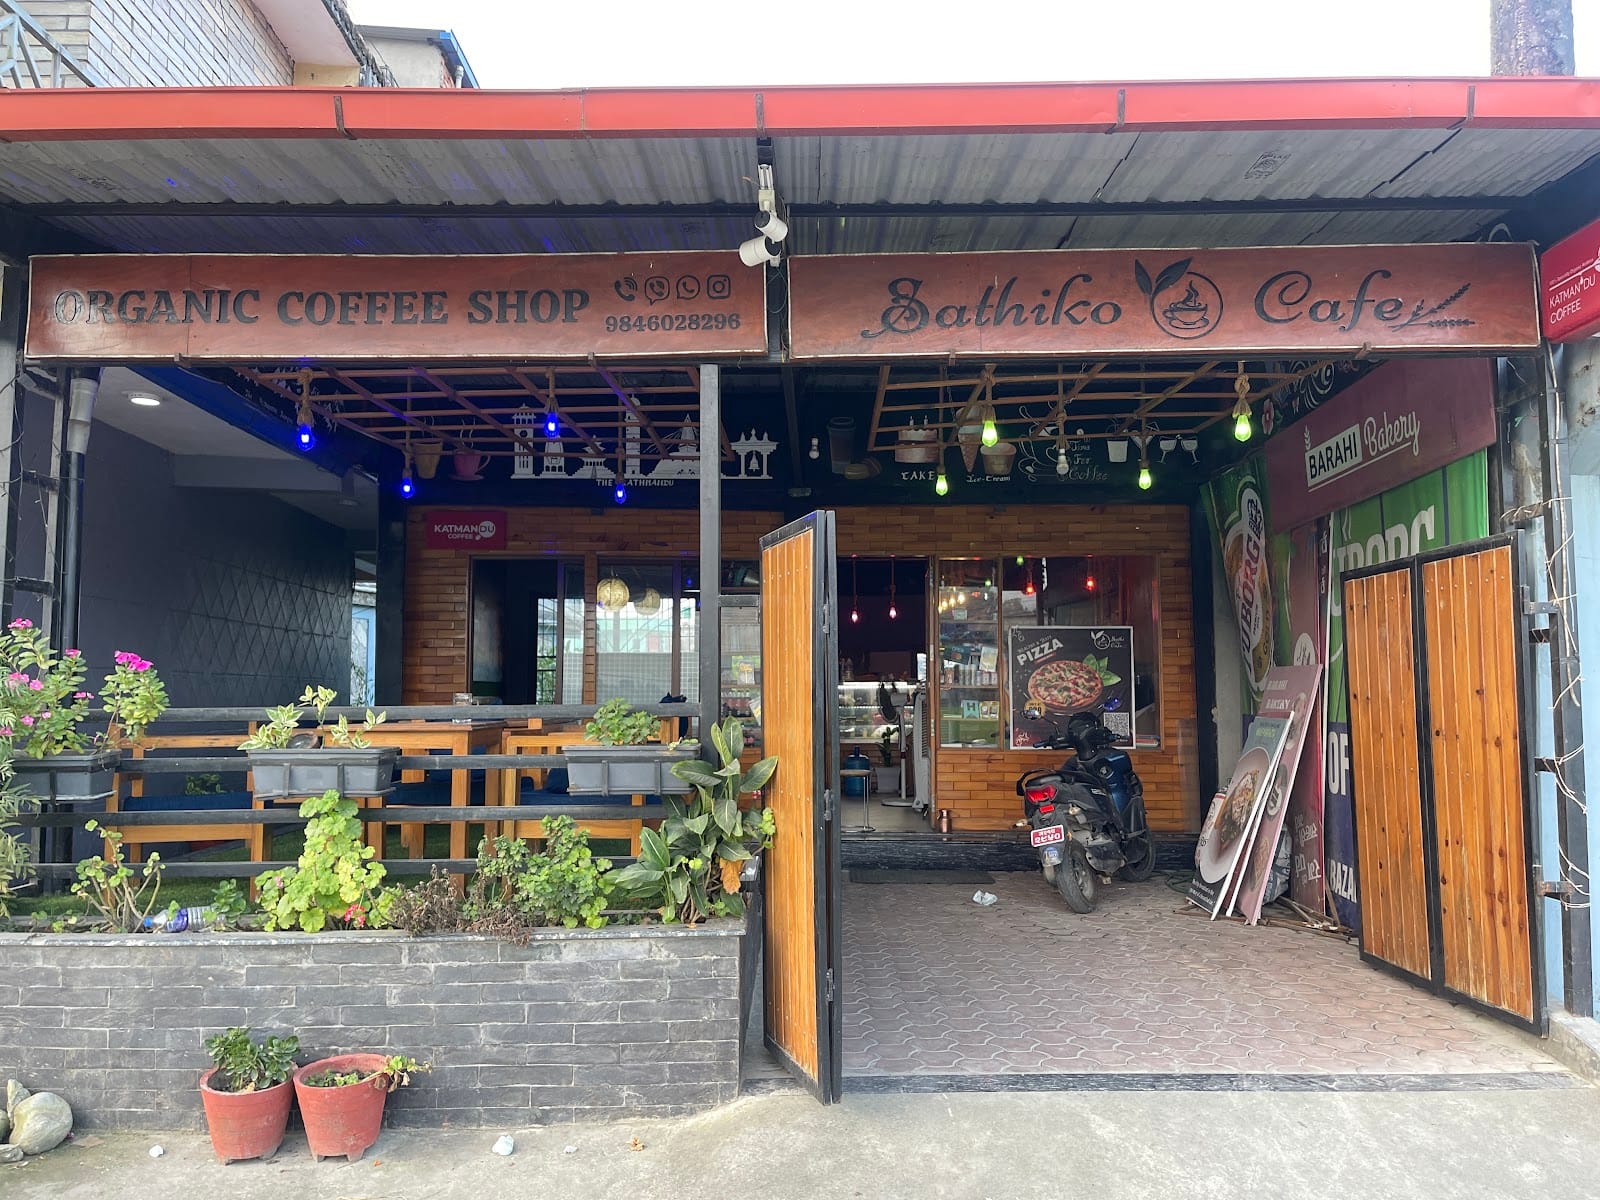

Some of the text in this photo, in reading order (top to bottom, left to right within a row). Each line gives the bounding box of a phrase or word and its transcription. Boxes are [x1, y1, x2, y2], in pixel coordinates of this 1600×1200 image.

[55, 288, 590, 325] ORGANIC COFFEE SHOP
[861, 269, 1404, 338] Sathiko Cafe
[1550, 298, 1581, 324] COFFEE
[605, 313, 741, 333] 9846028296
[1309, 411, 1421, 479] BARAHI Bakery
[596, 479, 675, 487] THE ATHMANDU
[900, 471, 935, 481] CAKE
[434, 524, 495, 533] KATMANDU
[1016, 638, 1064, 666] PIZZA
